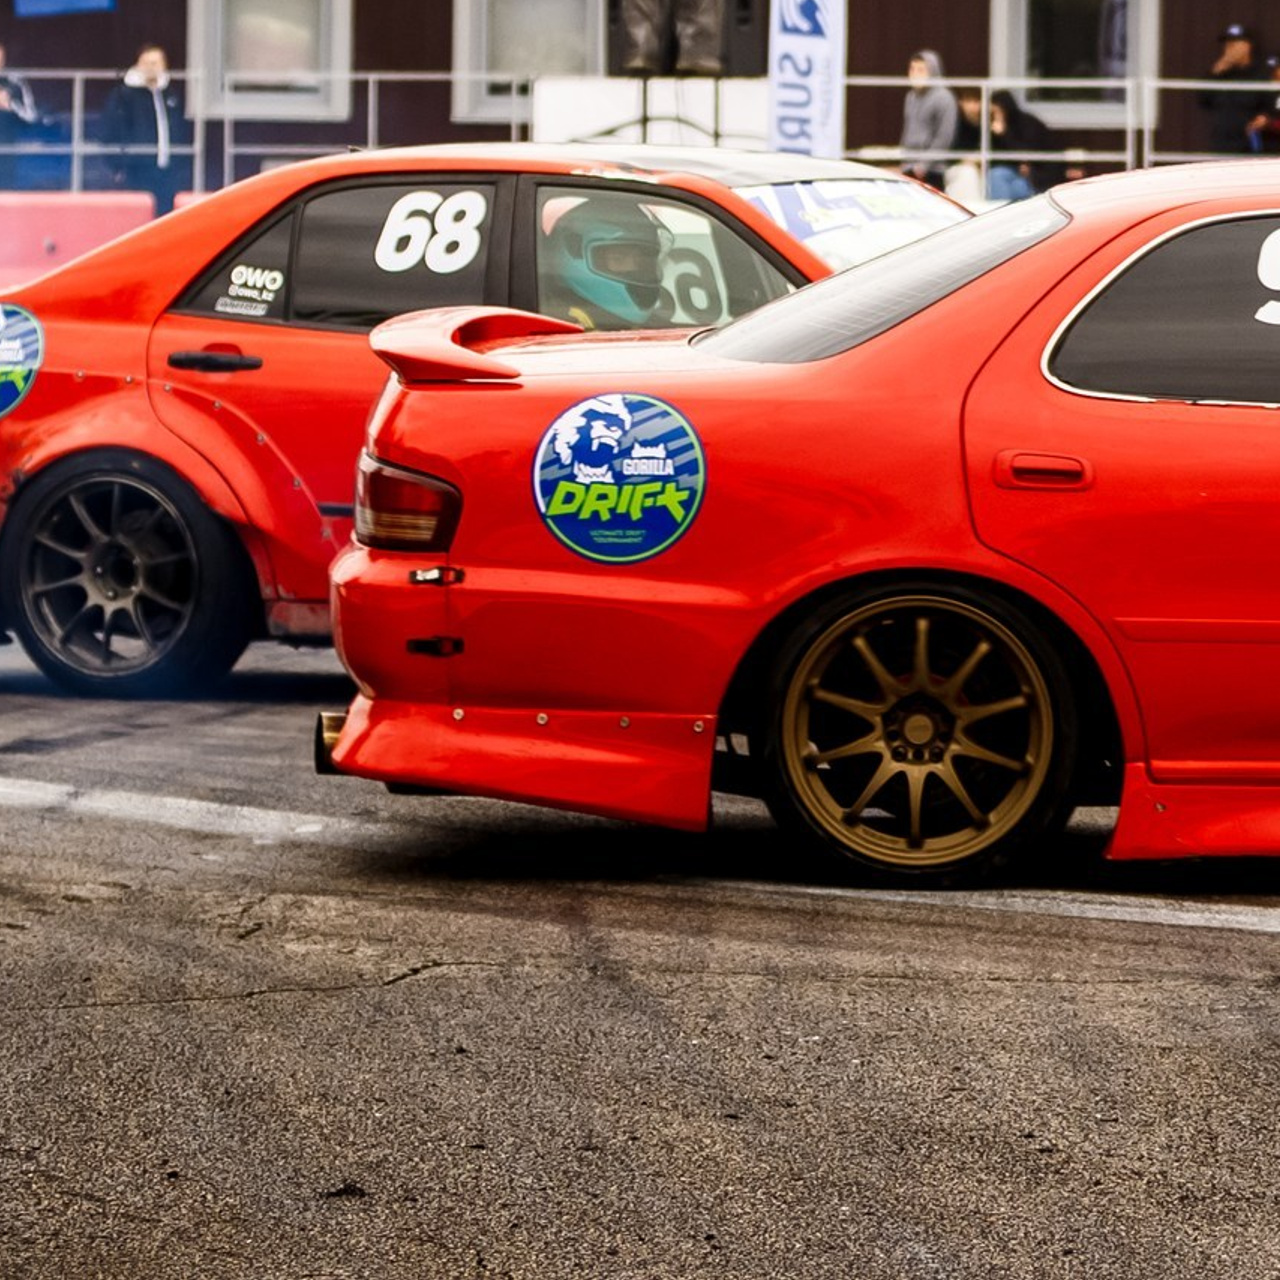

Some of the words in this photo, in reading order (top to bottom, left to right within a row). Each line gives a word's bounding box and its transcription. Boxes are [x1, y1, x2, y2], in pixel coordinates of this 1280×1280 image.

[374, 191, 487, 273] 68
[231, 265, 284, 291] OWO
[622, 458, 675, 476] GORILLA
